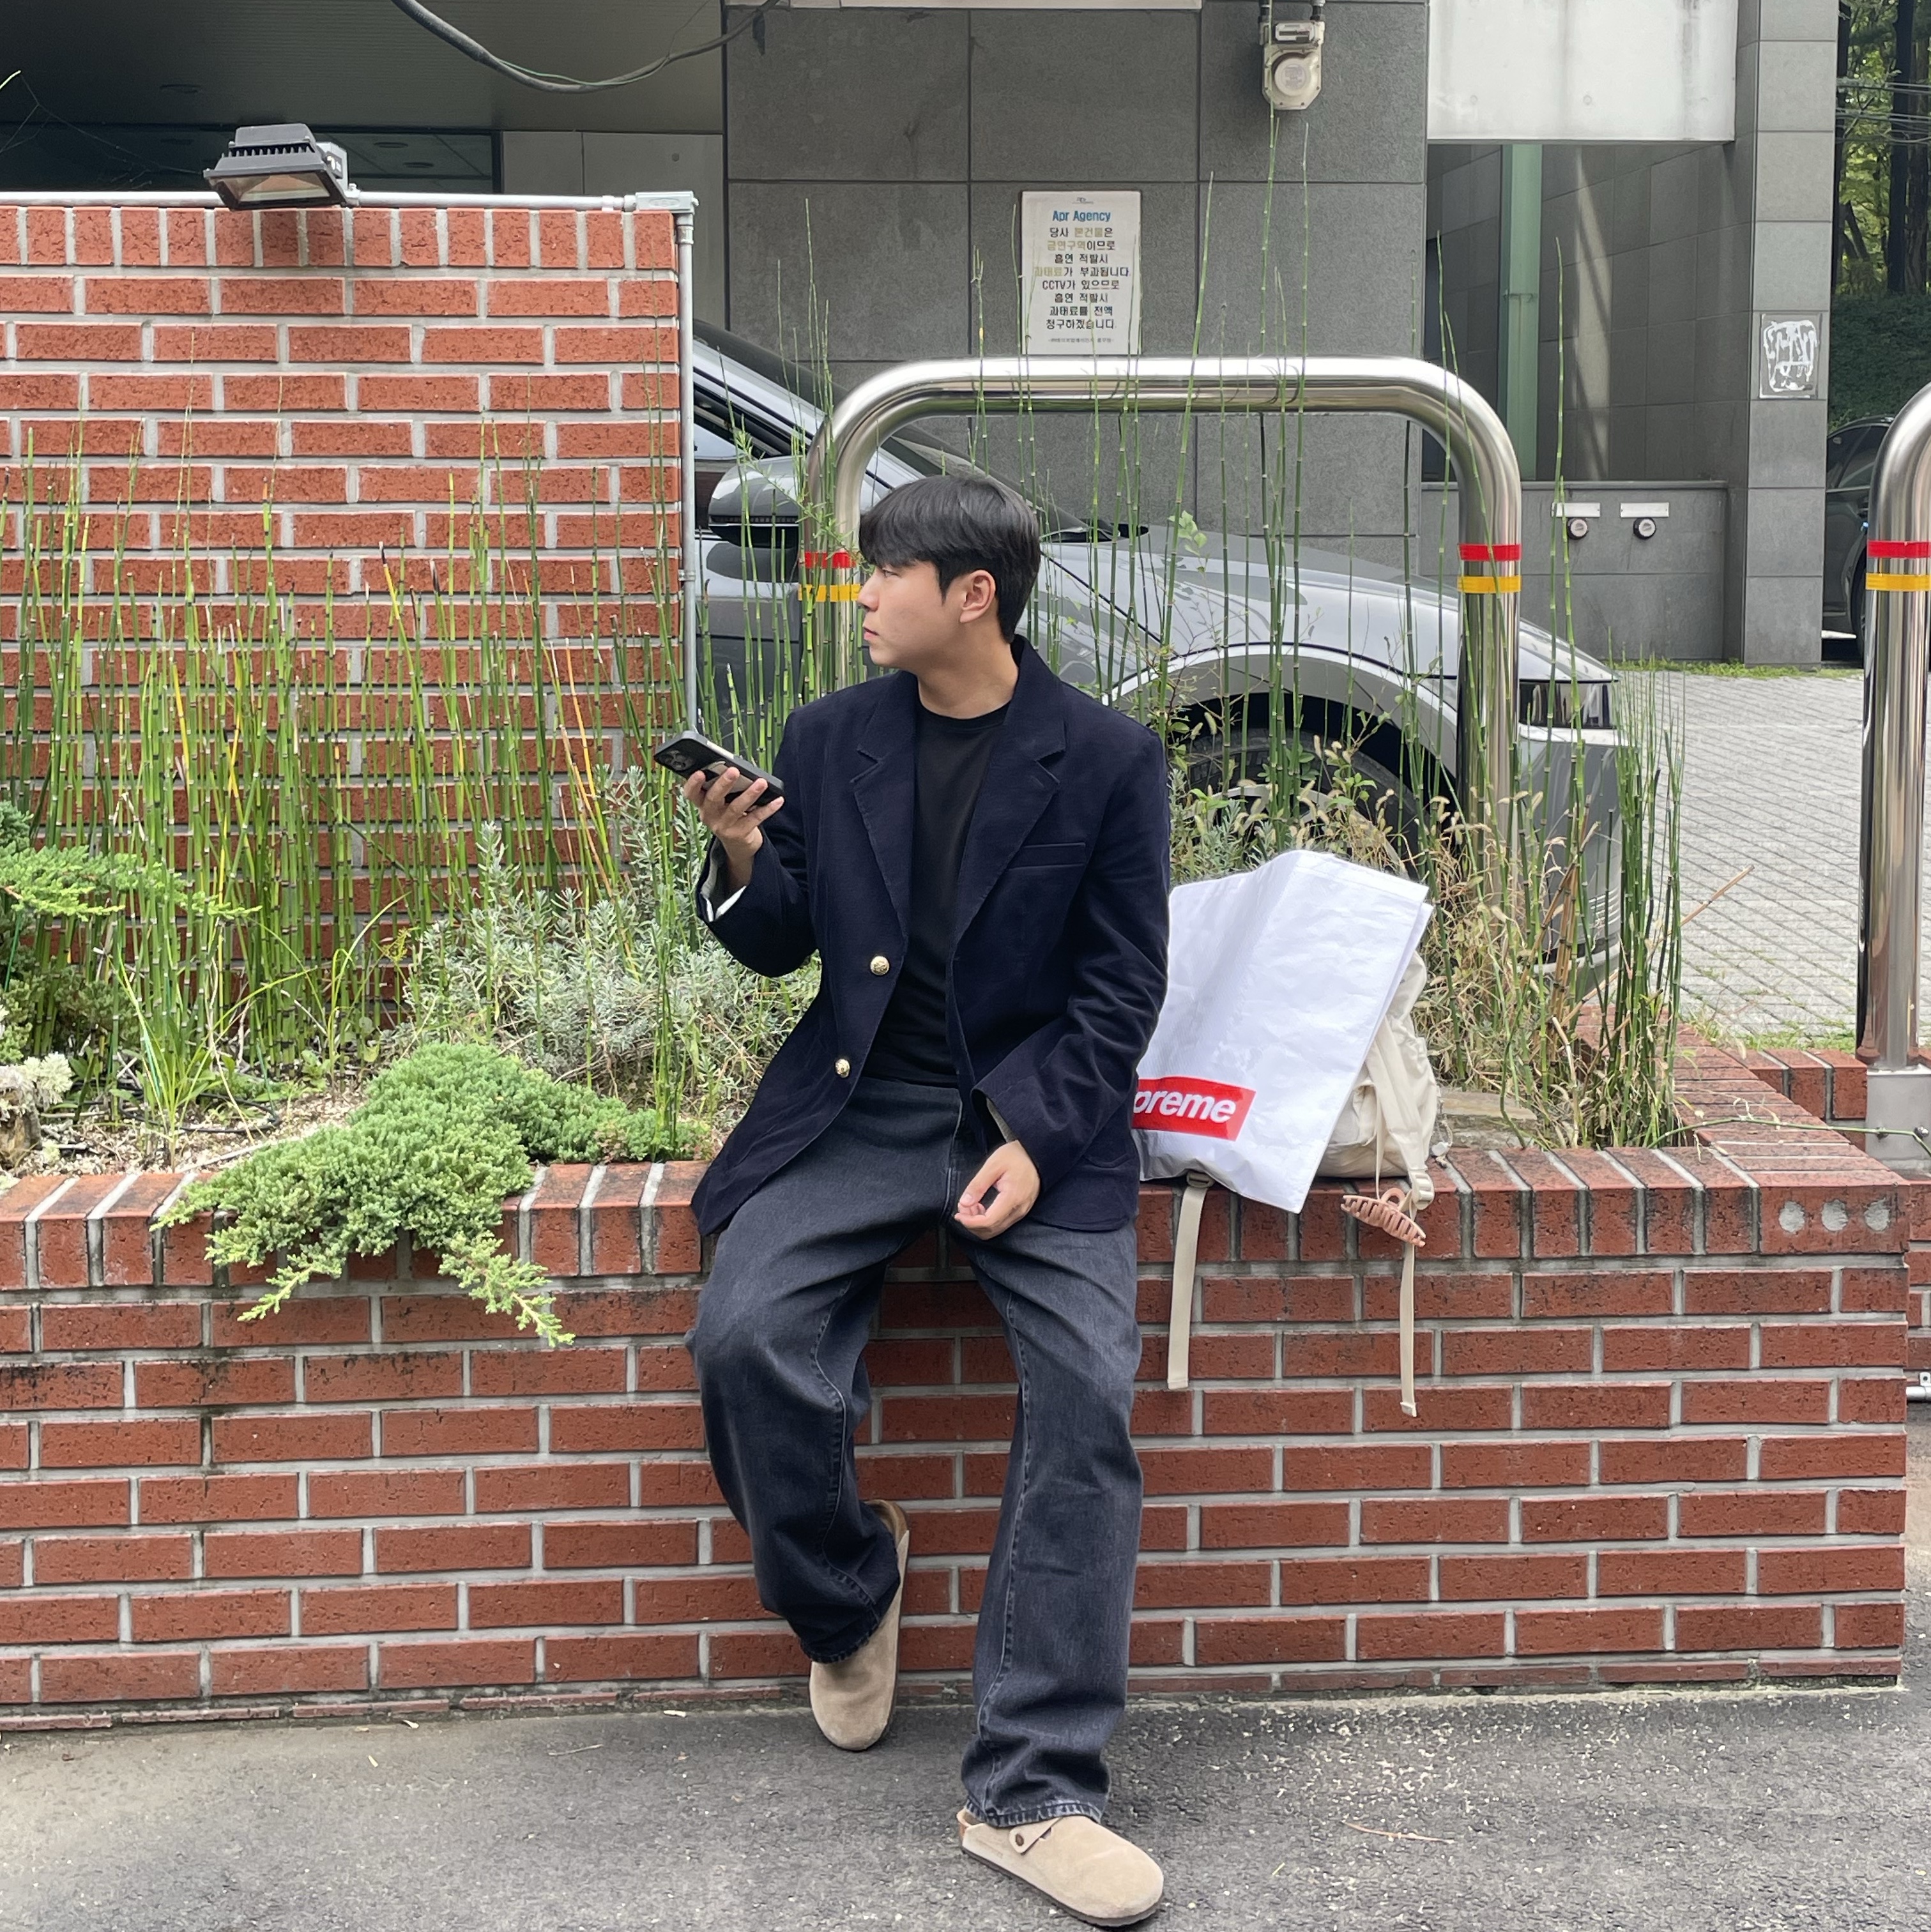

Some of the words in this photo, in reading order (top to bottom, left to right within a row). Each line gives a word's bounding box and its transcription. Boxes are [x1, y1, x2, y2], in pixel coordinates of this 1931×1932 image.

[1053, 210, 1069, 222] Apr
[1073, 210, 1111, 222] Agency
[1049, 227, 1069, 238] 당사
[1074, 227, 1113, 238] 본건물은
[1048, 240, 1115, 250] 금연구역이므로
[1055, 254, 1073, 264] 흡연
[1080, 254, 1108, 264] 적발시
[1034, 267, 1072, 277] 과태료가
[1042, 280, 1075, 290] CCTV가
[1081, 280, 1120, 290] 있으므로
[1055, 293, 1073, 303] 흡연
[1080, 293, 1108, 303] 적발시
[1049, 306, 1088, 316] 과태료를
[1094, 306, 1113, 316] 전액
